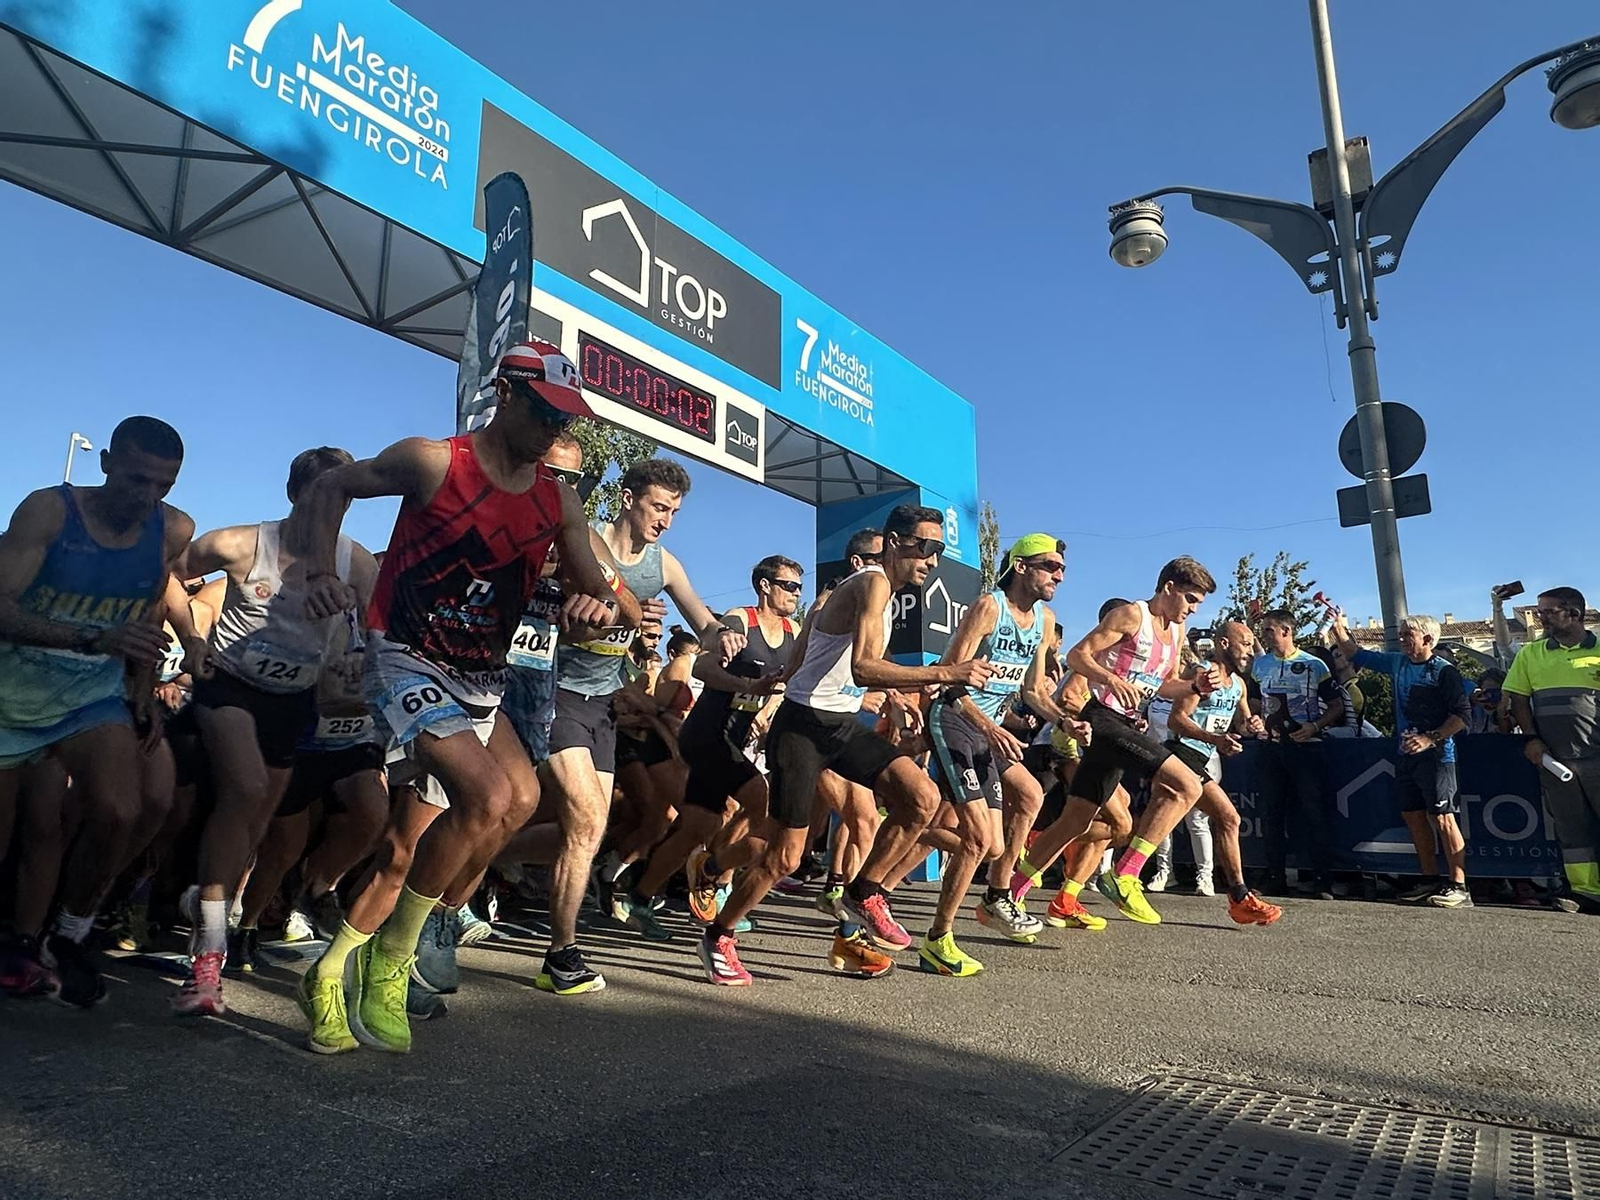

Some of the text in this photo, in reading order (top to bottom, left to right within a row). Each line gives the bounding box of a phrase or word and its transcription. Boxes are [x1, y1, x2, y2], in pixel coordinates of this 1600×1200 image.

[312, 32, 450, 143] Maratón
[337, 21, 439, 111] Media
[227, 42, 449, 190] FUENGIROLA
[417, 136, 445, 158] 2024
[654, 256, 727, 330] TOP
[661, 309, 714, 344] GESTIÓN
[796, 317, 819, 372] 7
[821, 350, 873, 397] Maratón
[828, 338, 867, 379] Media
[583, 344, 710, 435] 00:00:02
[795, 369, 874, 428] FUENGIROLA
[741, 431, 758, 448] TOP
[513, 631, 552, 655] 404
[255, 658, 302, 681] 124
[328, 719, 365, 734] 252
